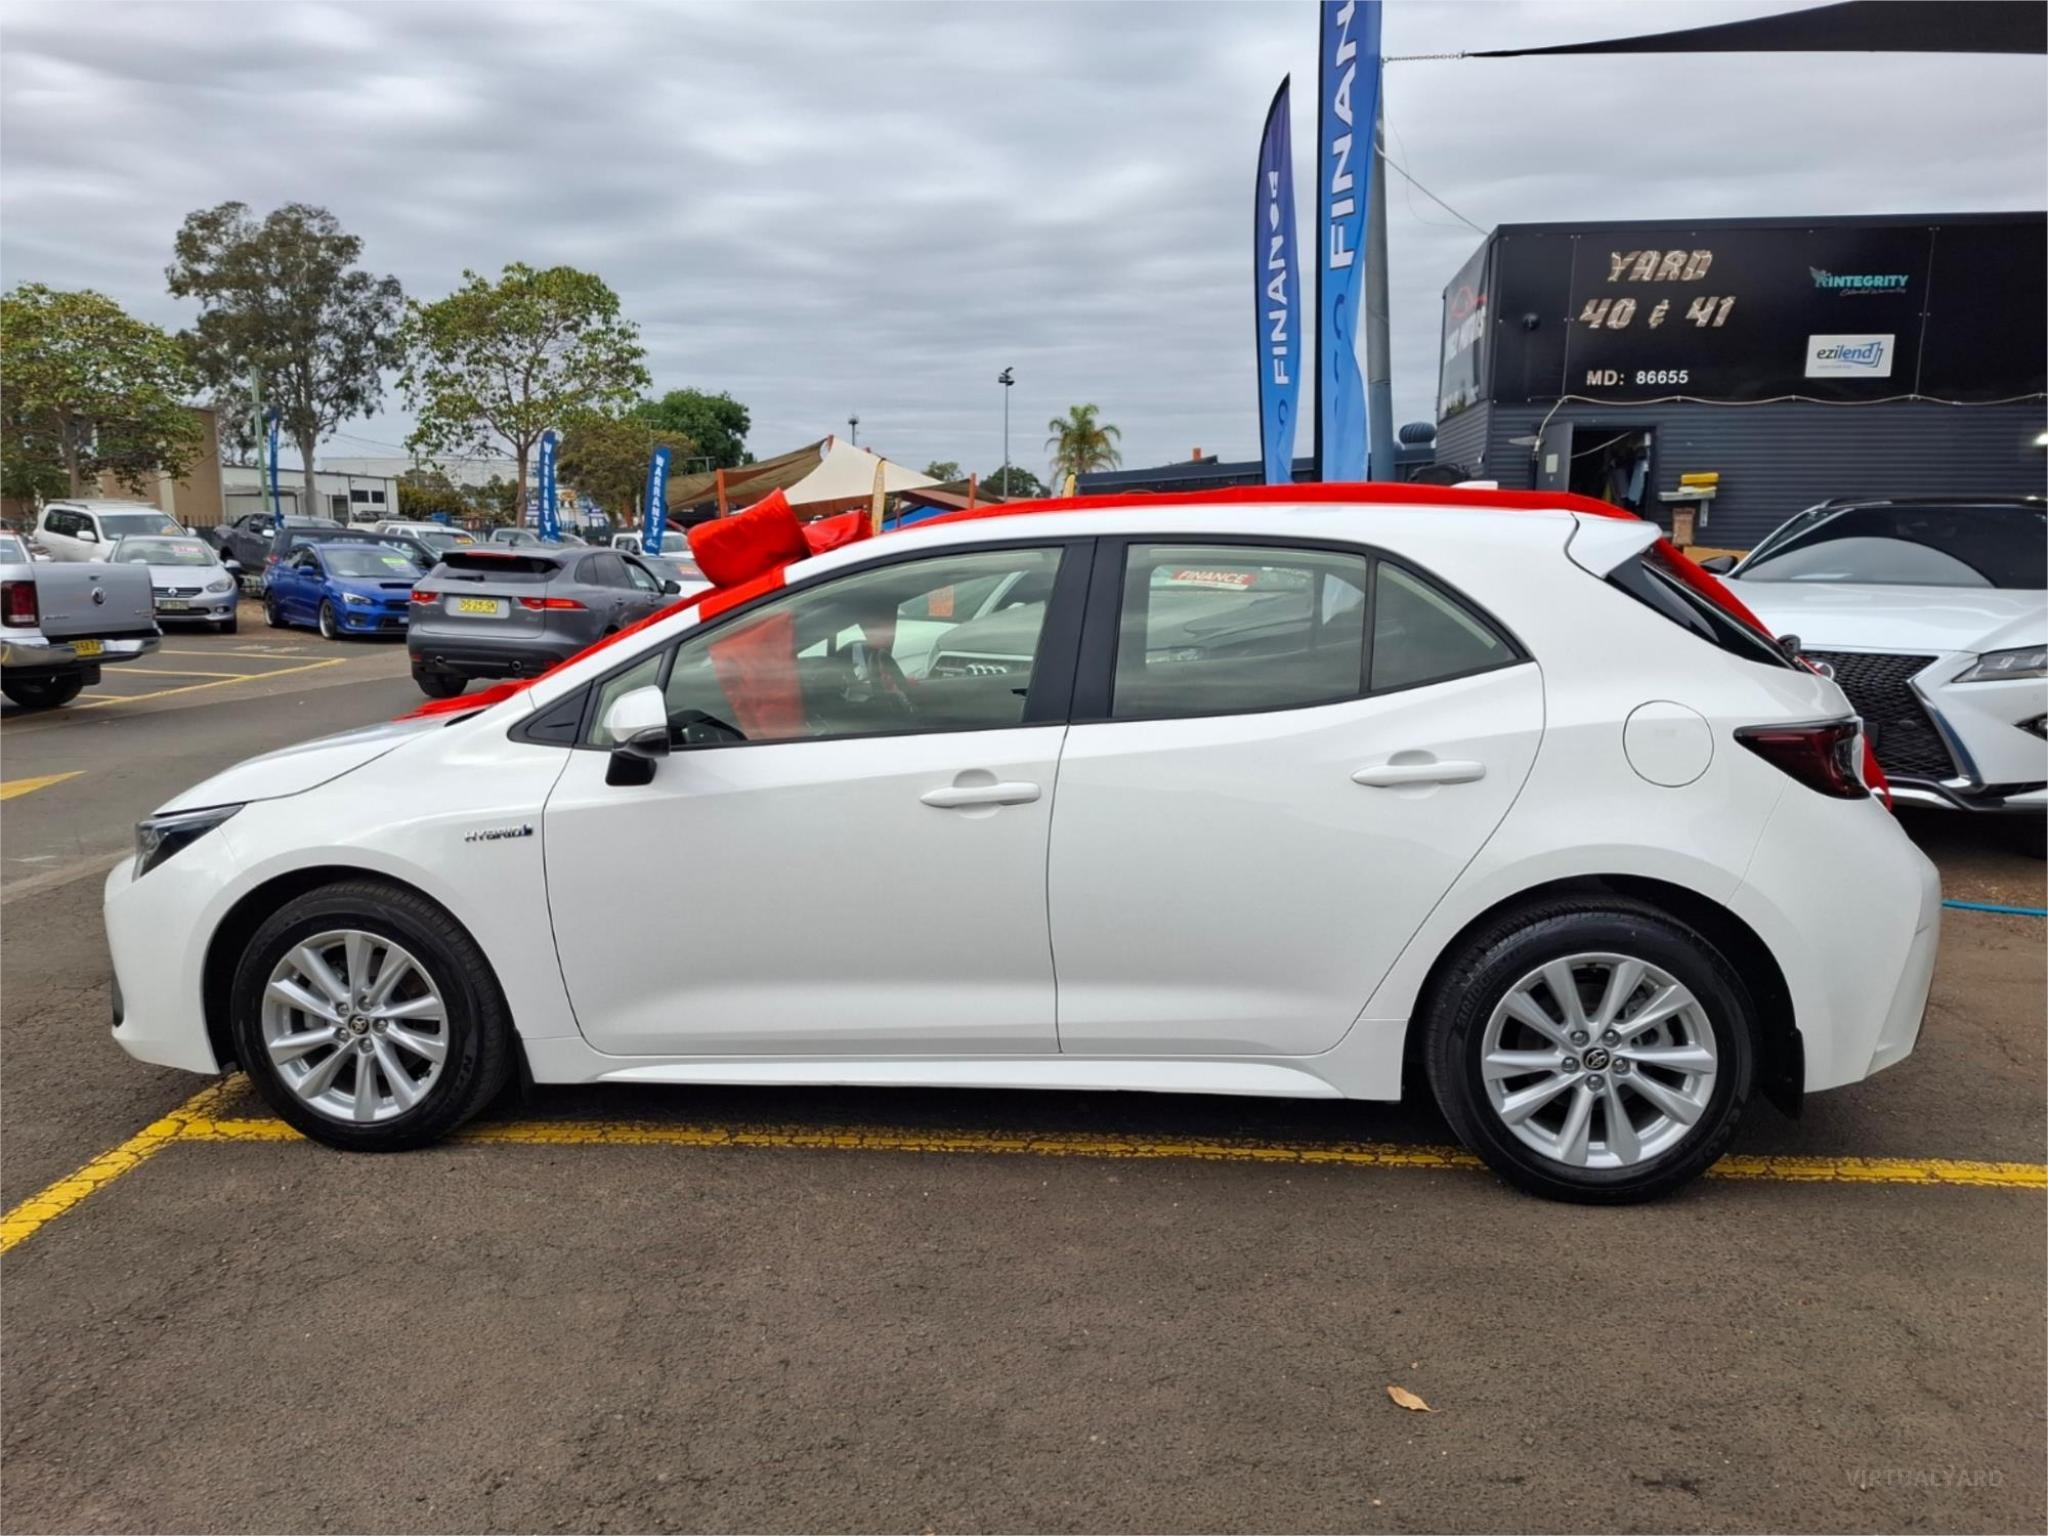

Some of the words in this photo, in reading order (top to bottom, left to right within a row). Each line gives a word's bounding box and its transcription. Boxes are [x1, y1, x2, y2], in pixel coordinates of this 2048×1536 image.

[1607, 249, 1713, 282] YARD
[1578, 297, 1638, 330] 40
[1685, 296, 1737, 328] 41
[1816, 343, 1875, 360] ezilend
[1586, 369, 1625, 387] MD:
[1635, 369, 1689, 385] 86655
[652, 453, 665, 538] WARRANTY
[1179, 569, 1249, 584] FINANCE
